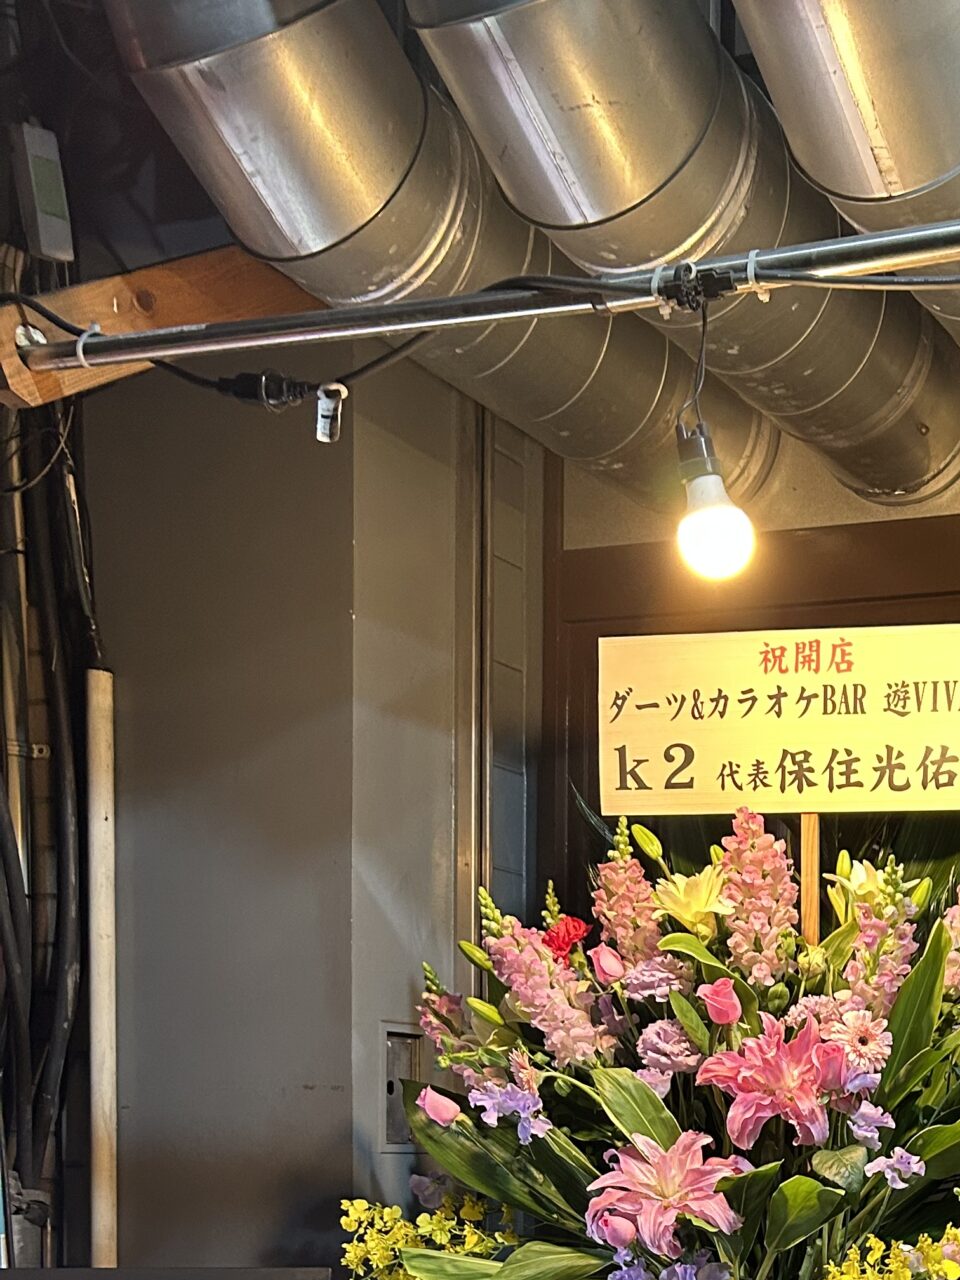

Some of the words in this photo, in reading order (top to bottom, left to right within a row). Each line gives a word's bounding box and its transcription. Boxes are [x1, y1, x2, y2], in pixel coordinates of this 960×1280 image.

[758, 637, 856, 675] 祝開店
[608, 683, 867, 724] ダーツ&カラオケBAR
